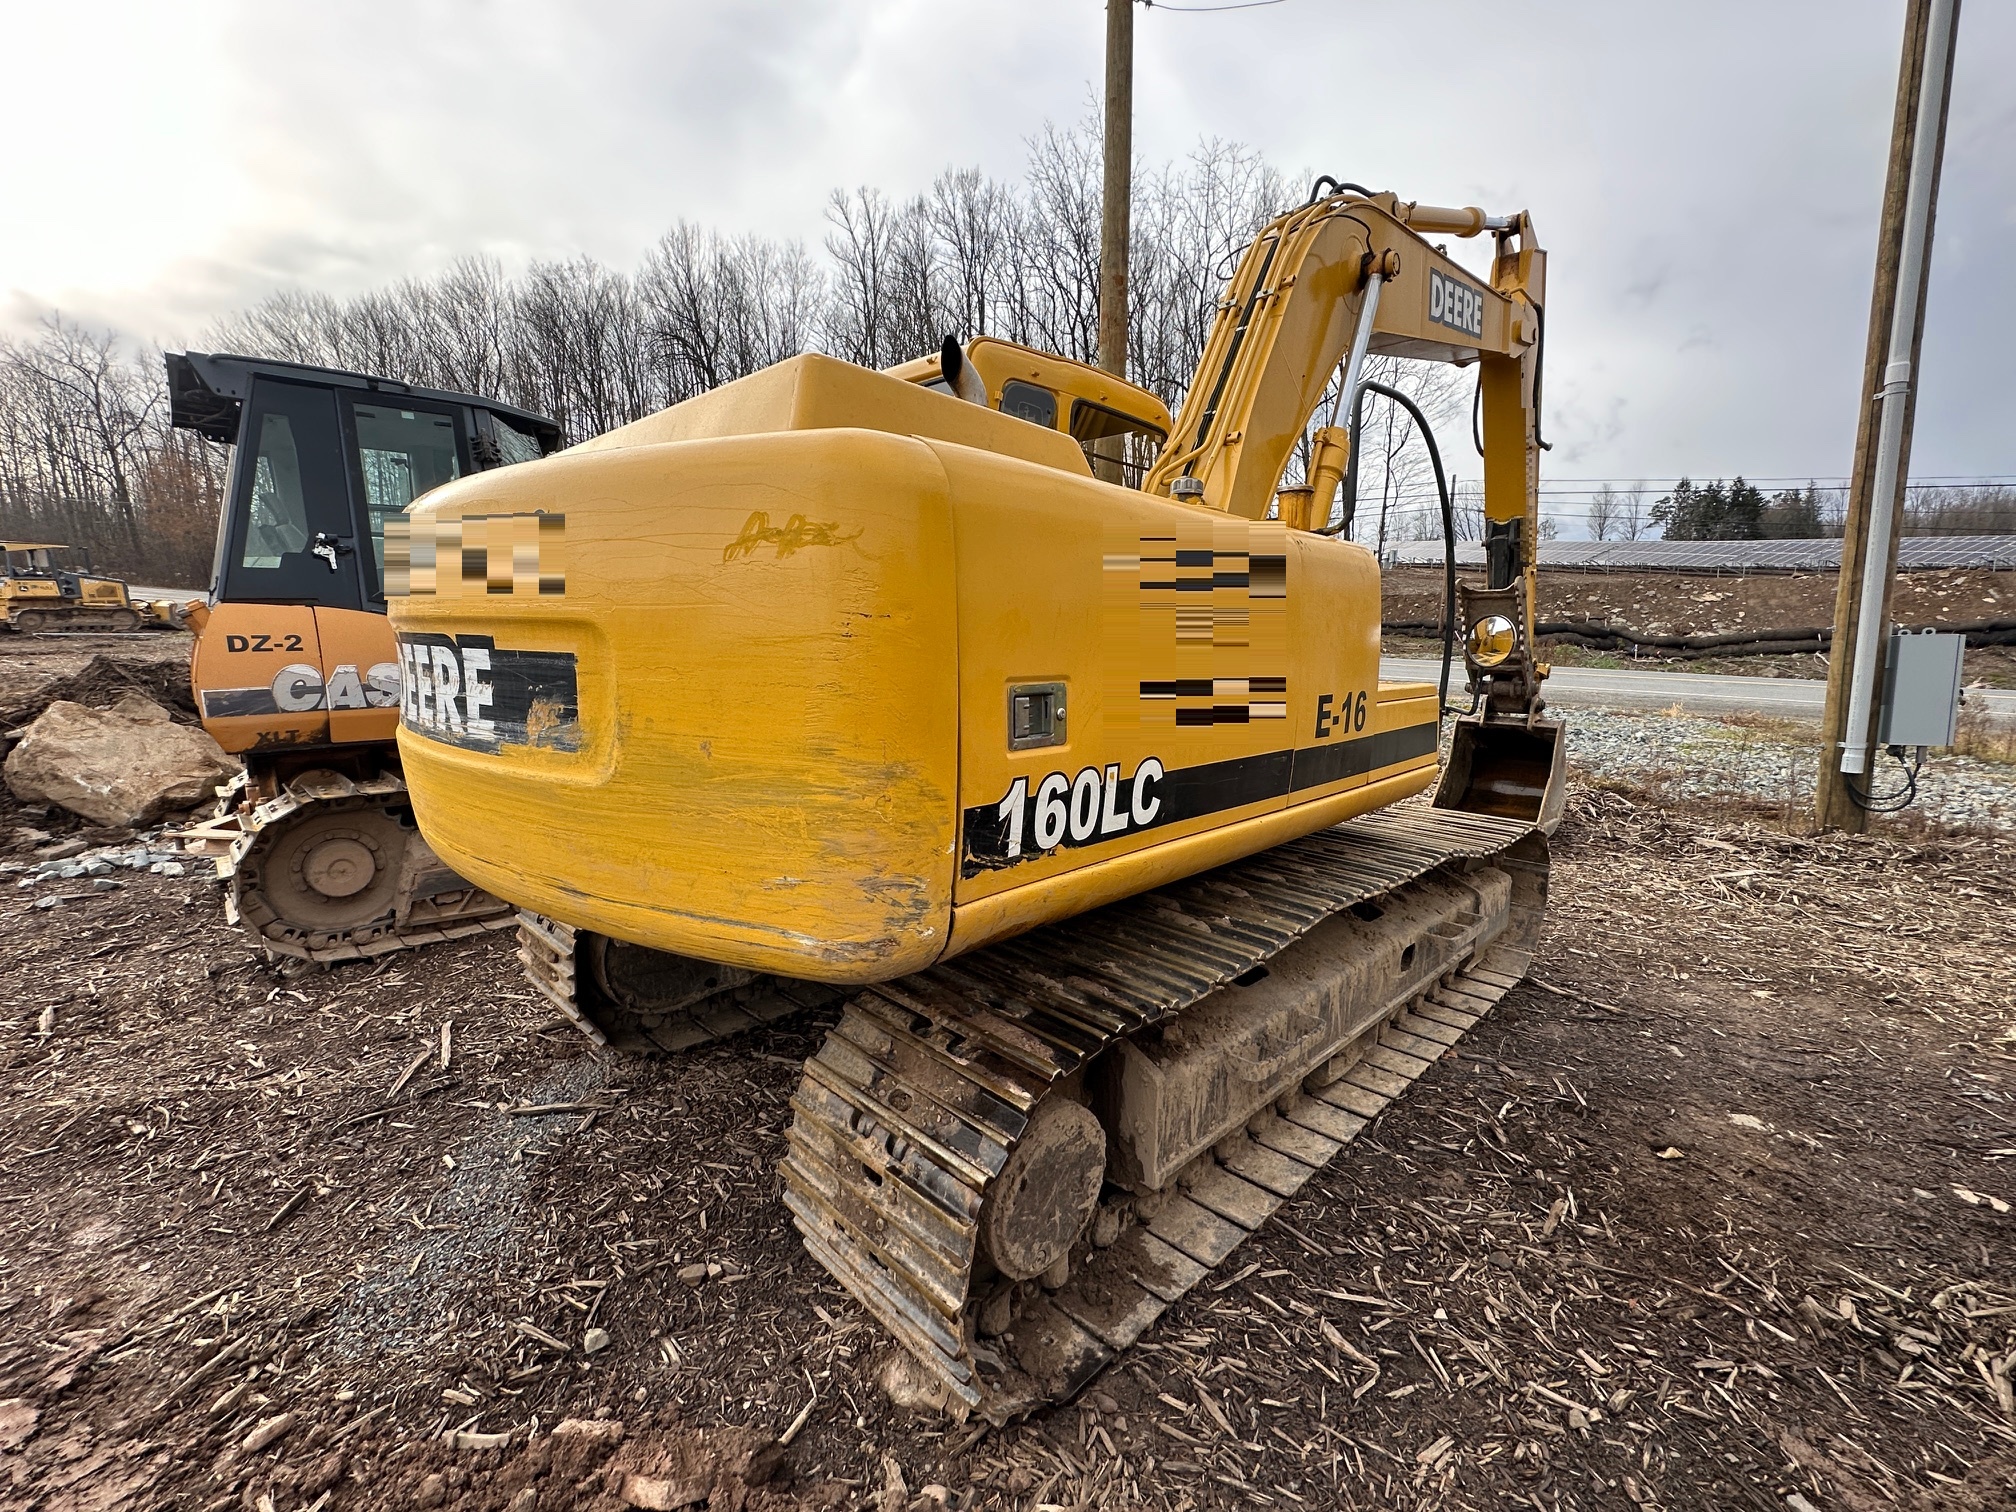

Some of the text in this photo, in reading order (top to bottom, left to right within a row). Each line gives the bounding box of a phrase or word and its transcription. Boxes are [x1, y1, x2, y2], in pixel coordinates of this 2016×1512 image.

[1431, 273, 1482, 334] DEERE
[226, 634, 304, 653] DZ-2
[272, 664, 399, 711] CAS
[256, 729, 300, 746] XLT
[1315, 691, 1366, 738] E-16
[999, 758, 1164, 858] 160LC
